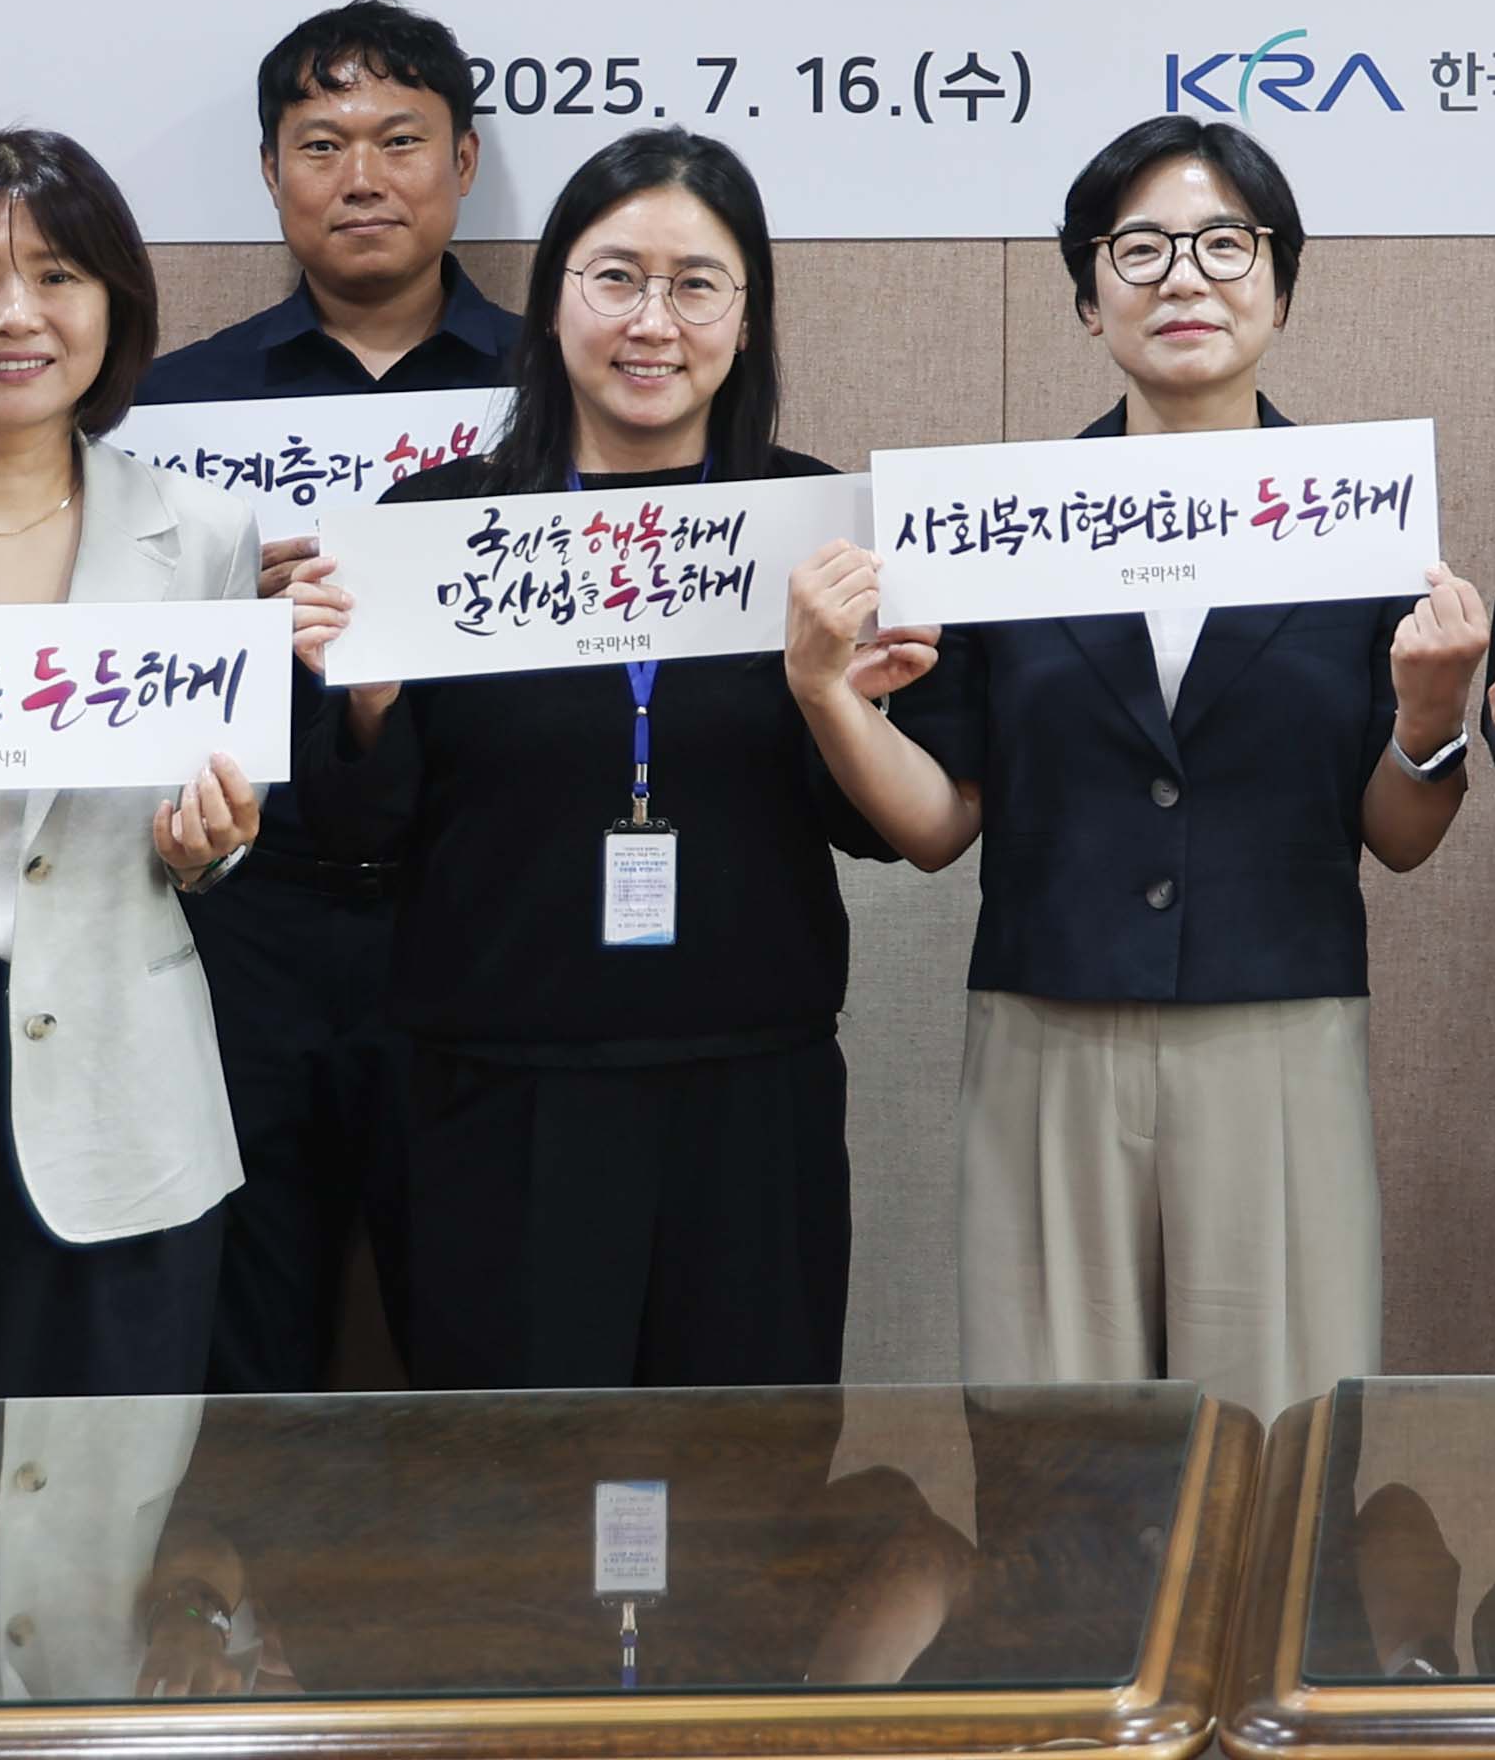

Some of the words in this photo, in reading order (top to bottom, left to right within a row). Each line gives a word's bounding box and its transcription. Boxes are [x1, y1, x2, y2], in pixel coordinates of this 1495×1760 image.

[696, 55, 761, 118] 7.
[795, 49, 1032, 124] 16.(수)
[1164, 28, 1406, 128] KRA
[466, 507, 572, 581] 국민을
[582, 502, 747, 569] 행복하게
[895, 490, 1238, 556] 사회복지협의회와
[1250, 474, 1413, 541] 든든하게
[603, 559, 755, 622] 든든하게
[1122, 565, 1195, 584] 한국마사회
[577, 634, 650, 654] 한국마사회
[21, 647, 247, 731] 든든하게
